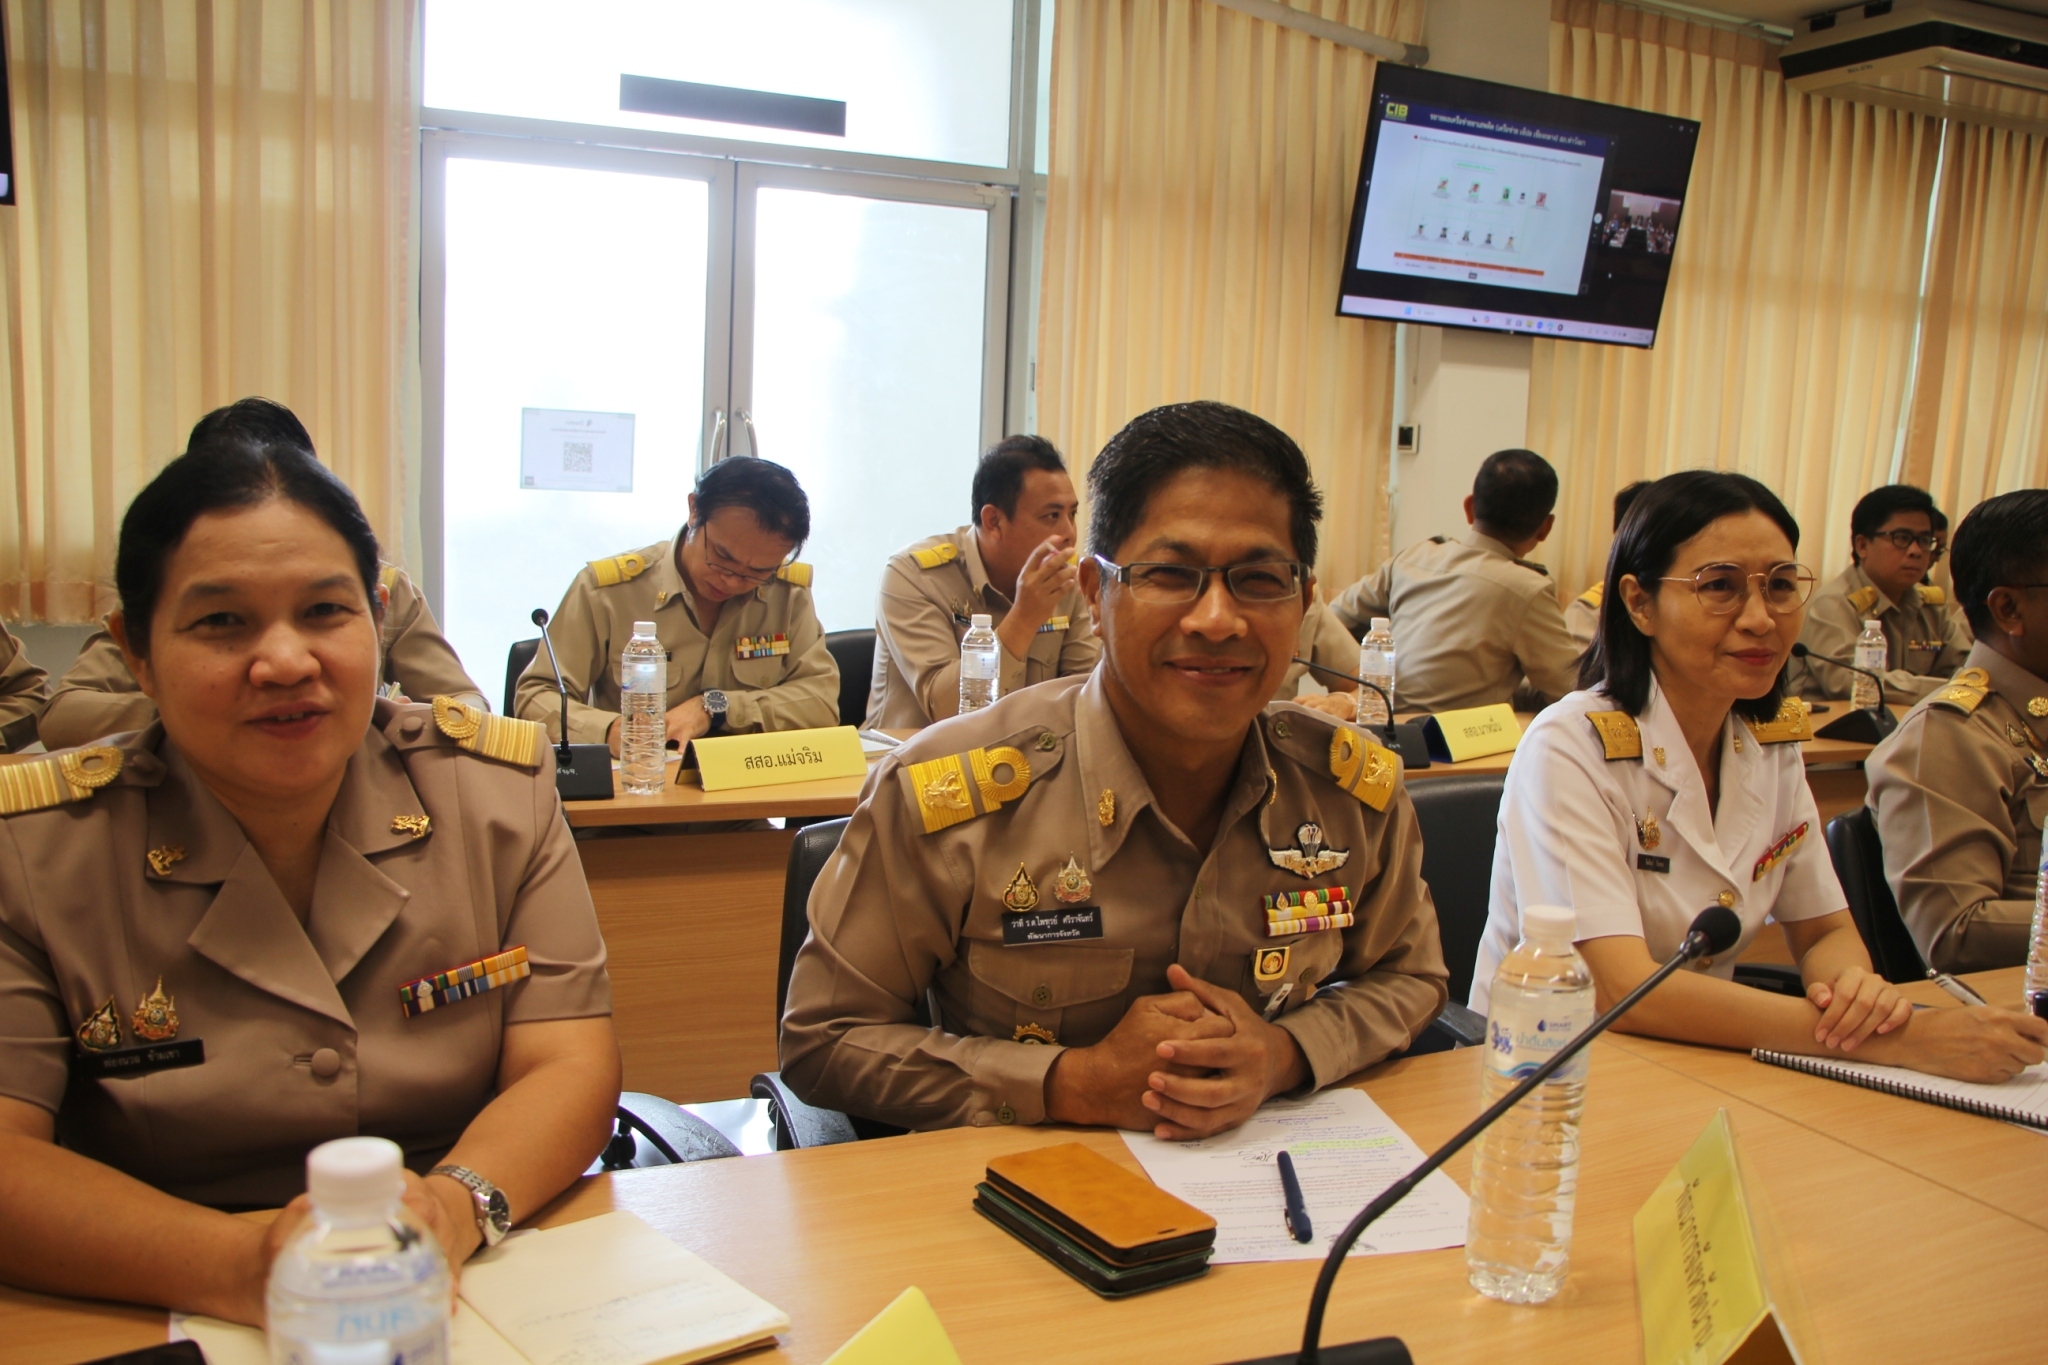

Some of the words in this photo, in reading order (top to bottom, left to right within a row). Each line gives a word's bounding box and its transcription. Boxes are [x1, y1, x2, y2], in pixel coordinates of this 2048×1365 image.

[1386, 102, 1408, 117] CIB
[744, 746, 823, 770] สสอ.แม่จริม
[1027, 928, 1080, 940] พัฒนาการจังหวัด
[1675, 1177, 1720, 1354] พัฒนาการจังหวัดน่าน
